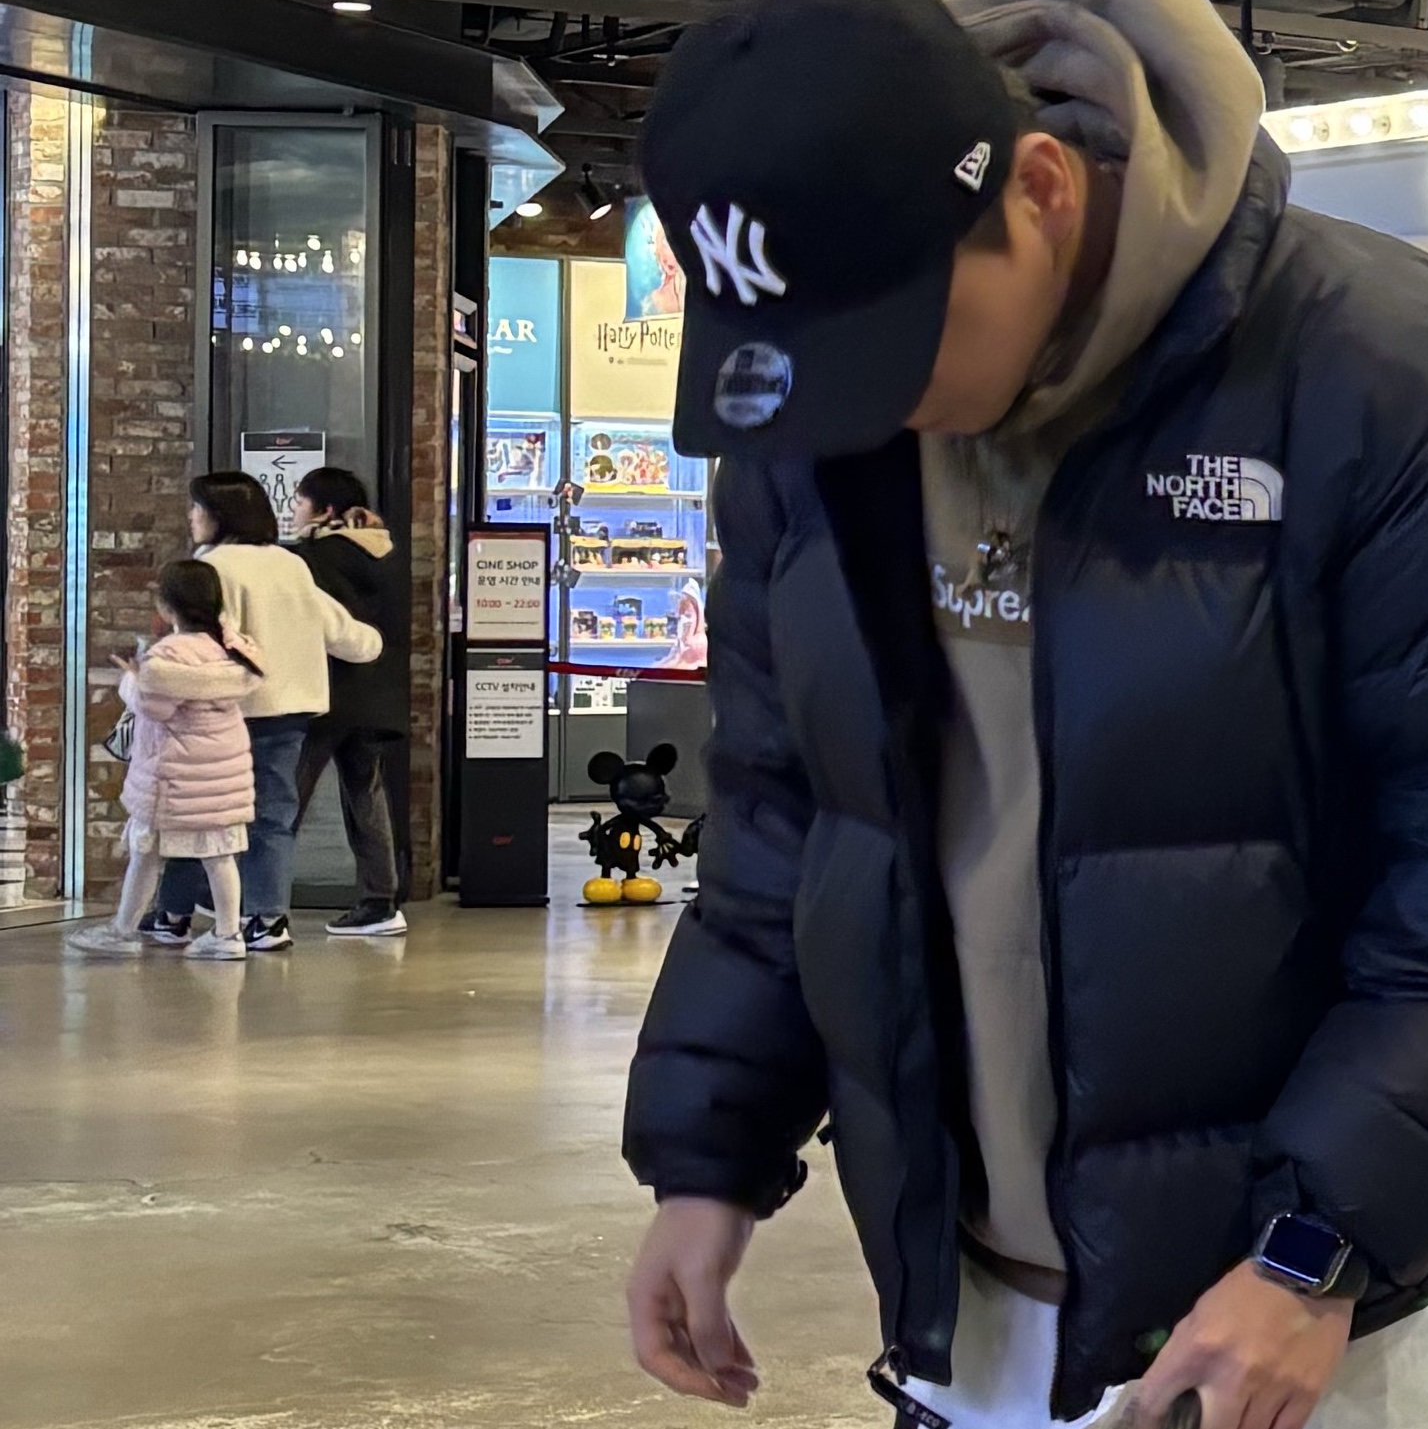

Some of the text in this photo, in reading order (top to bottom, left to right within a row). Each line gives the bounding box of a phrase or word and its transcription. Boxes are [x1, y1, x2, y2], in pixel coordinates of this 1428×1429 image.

[690, 203, 787, 307] NY
[597, 323, 637, 352] Harry
[1186, 454, 1241, 478] THE
[1146, 473, 1241, 500] NORTH
[1172, 495, 1241, 521] FACE
[476, 560, 539, 570] CINE SHOP
[499, 576, 518, 585] 시간
[521, 575, 540, 586] 안내
[514, 599, 540, 608] 22:00
[931, 564, 1030, 629] Supre
[475, 682, 499, 691] CCTV
